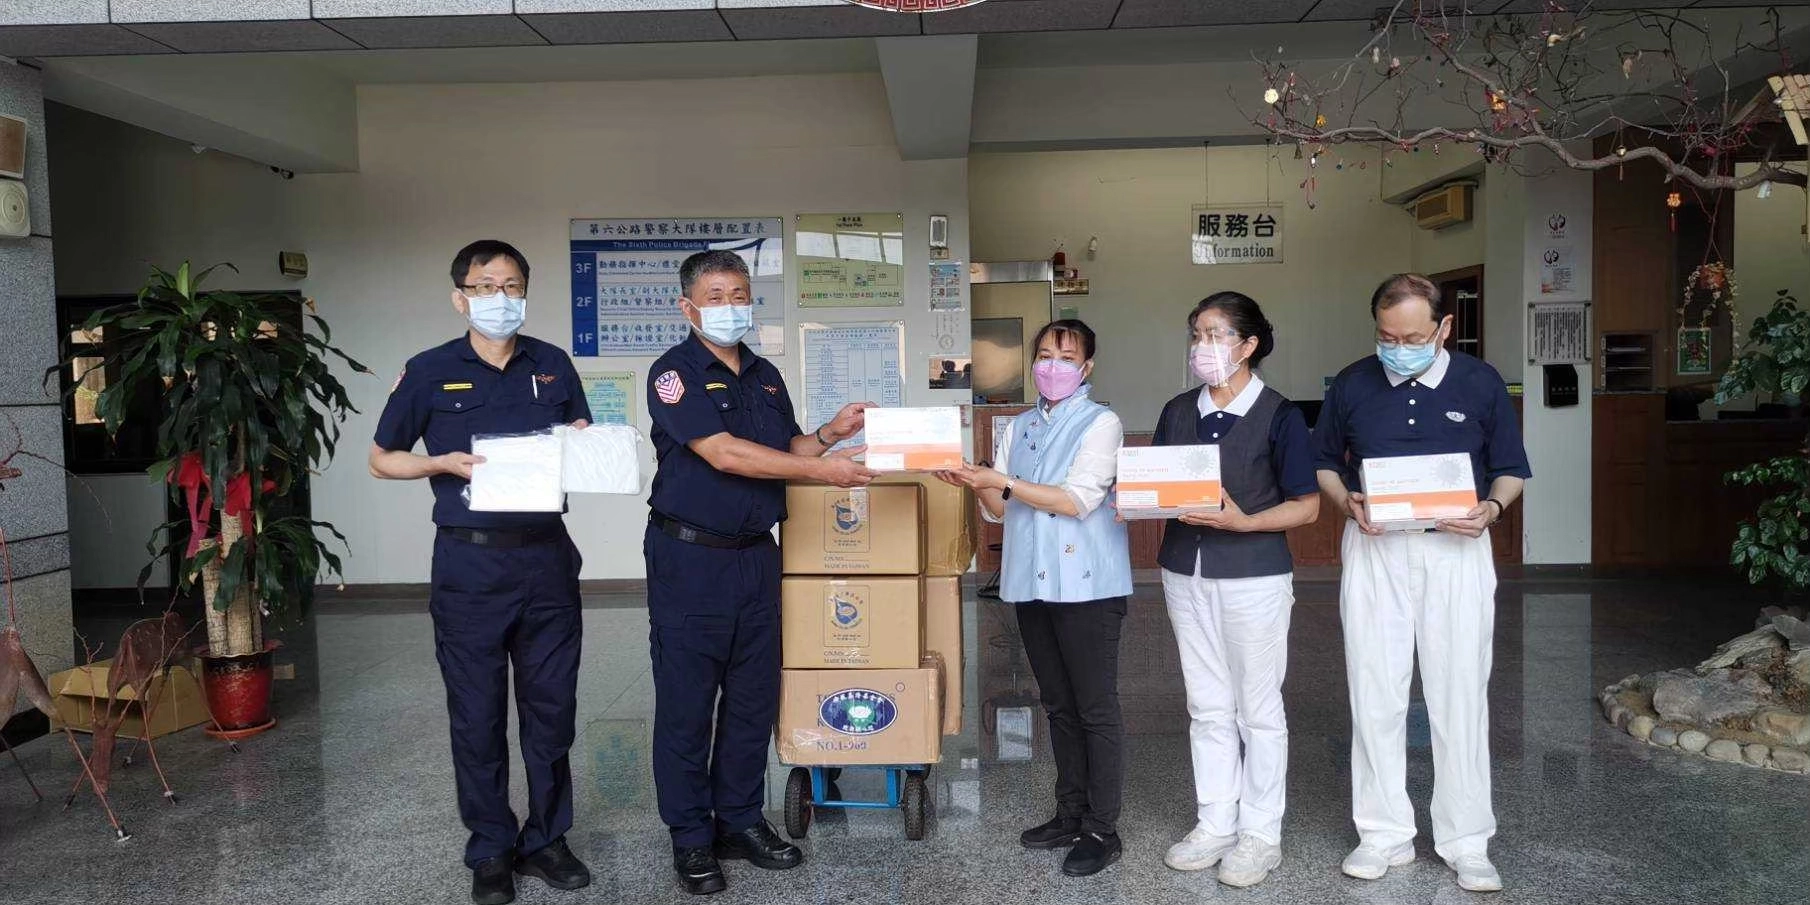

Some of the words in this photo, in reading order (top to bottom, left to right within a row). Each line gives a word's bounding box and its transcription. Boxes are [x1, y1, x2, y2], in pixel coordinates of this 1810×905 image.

[1198, 213, 1276, 238] 服務台
[575, 262, 591, 274] 3F
[576, 296, 592, 307] 2F
[577, 332, 593, 344] 1F
